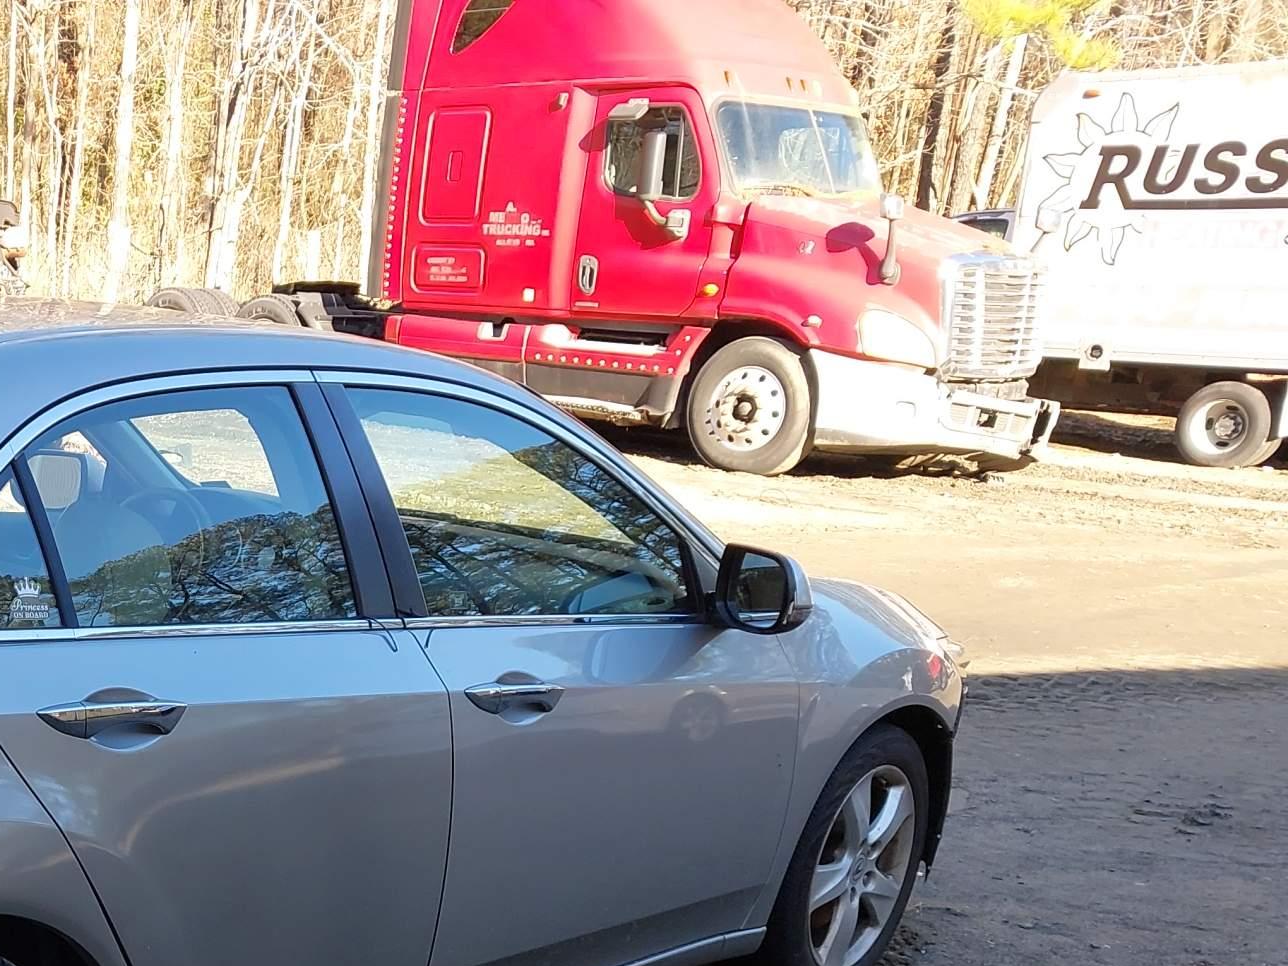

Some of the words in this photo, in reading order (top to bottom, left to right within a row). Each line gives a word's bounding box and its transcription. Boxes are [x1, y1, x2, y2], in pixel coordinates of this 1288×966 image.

[482, 224, 541, 236] TRUCKING
[12, 598, 49, 611] Princess
[25, 611, 49, 619] BOARD
